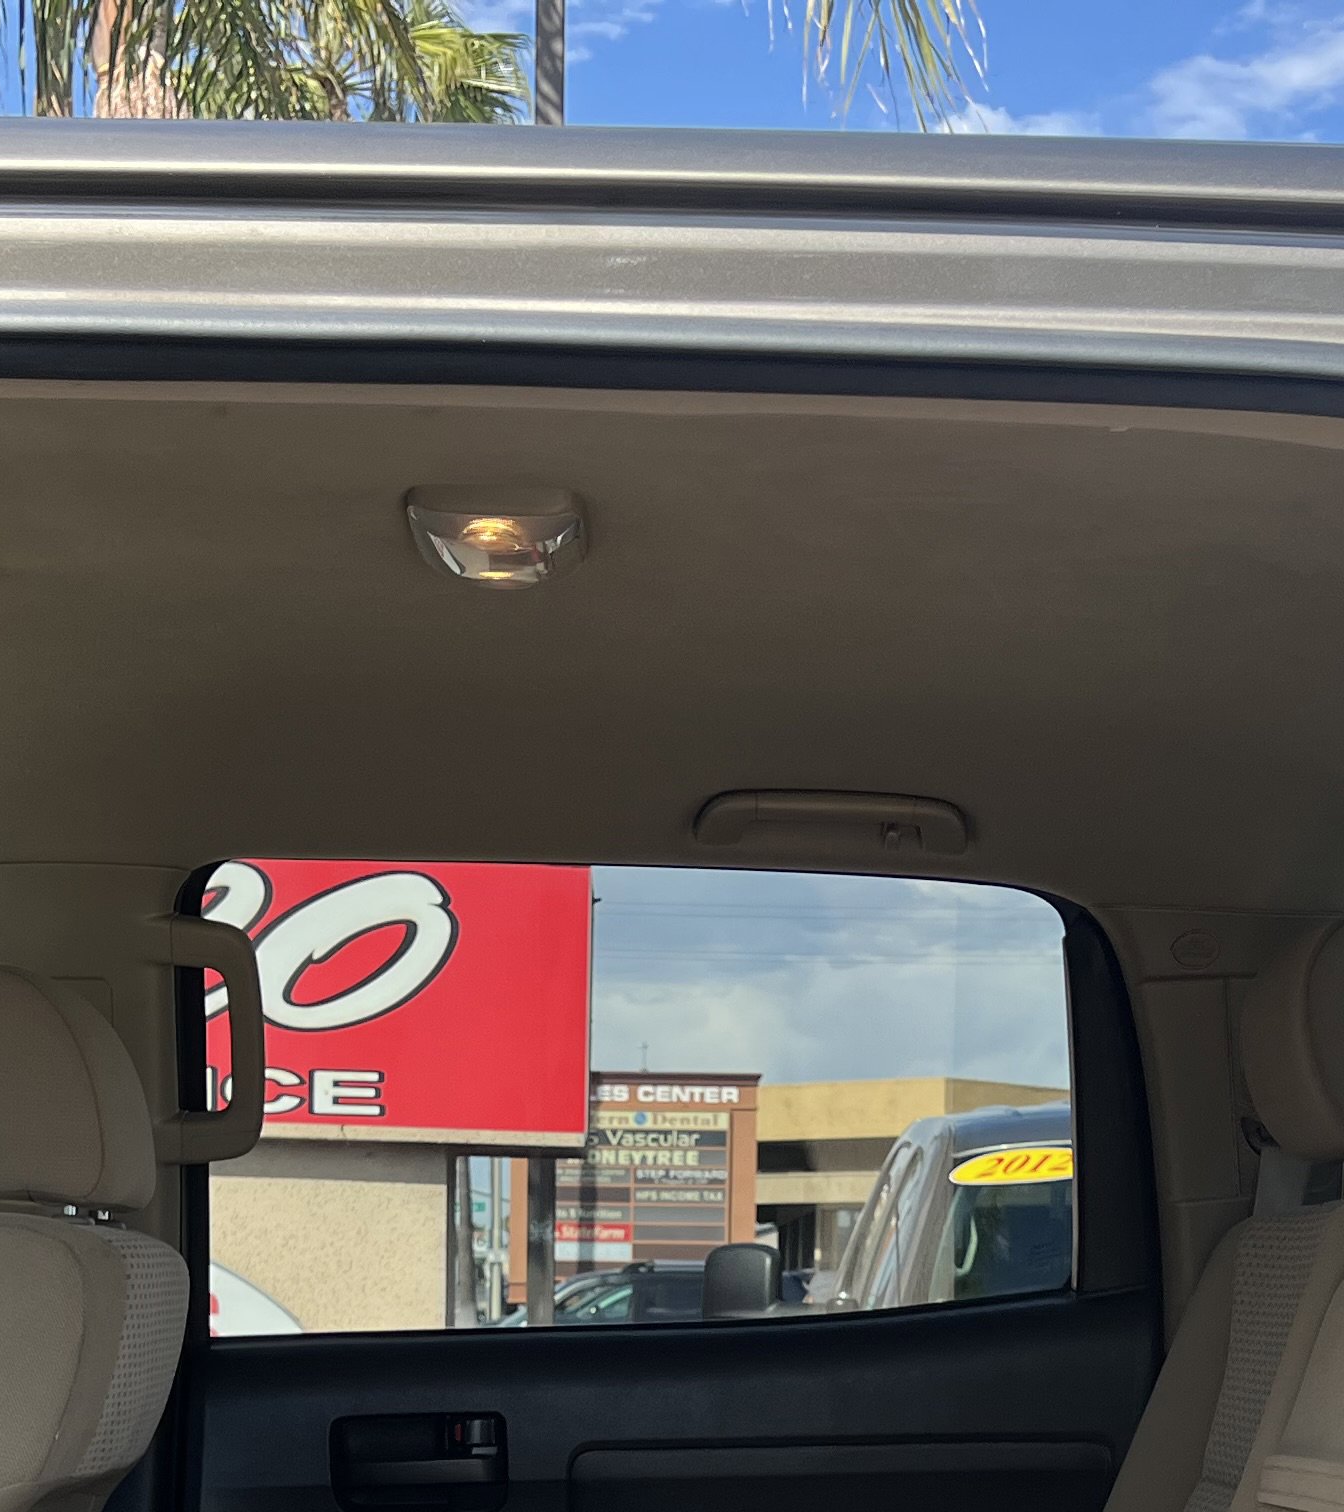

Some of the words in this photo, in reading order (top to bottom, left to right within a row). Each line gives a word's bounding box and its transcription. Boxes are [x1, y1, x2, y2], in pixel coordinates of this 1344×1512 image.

[590, 1085, 630, 1102] ES
[637, 1085, 740, 1104] CENTER
[652, 1113, 719, 1127] Dental
[606, 1130, 701, 1148] Vascular
[567, 1150, 700, 1166] ONEYTREE
[975, 1153, 1073, 1179] 2012
